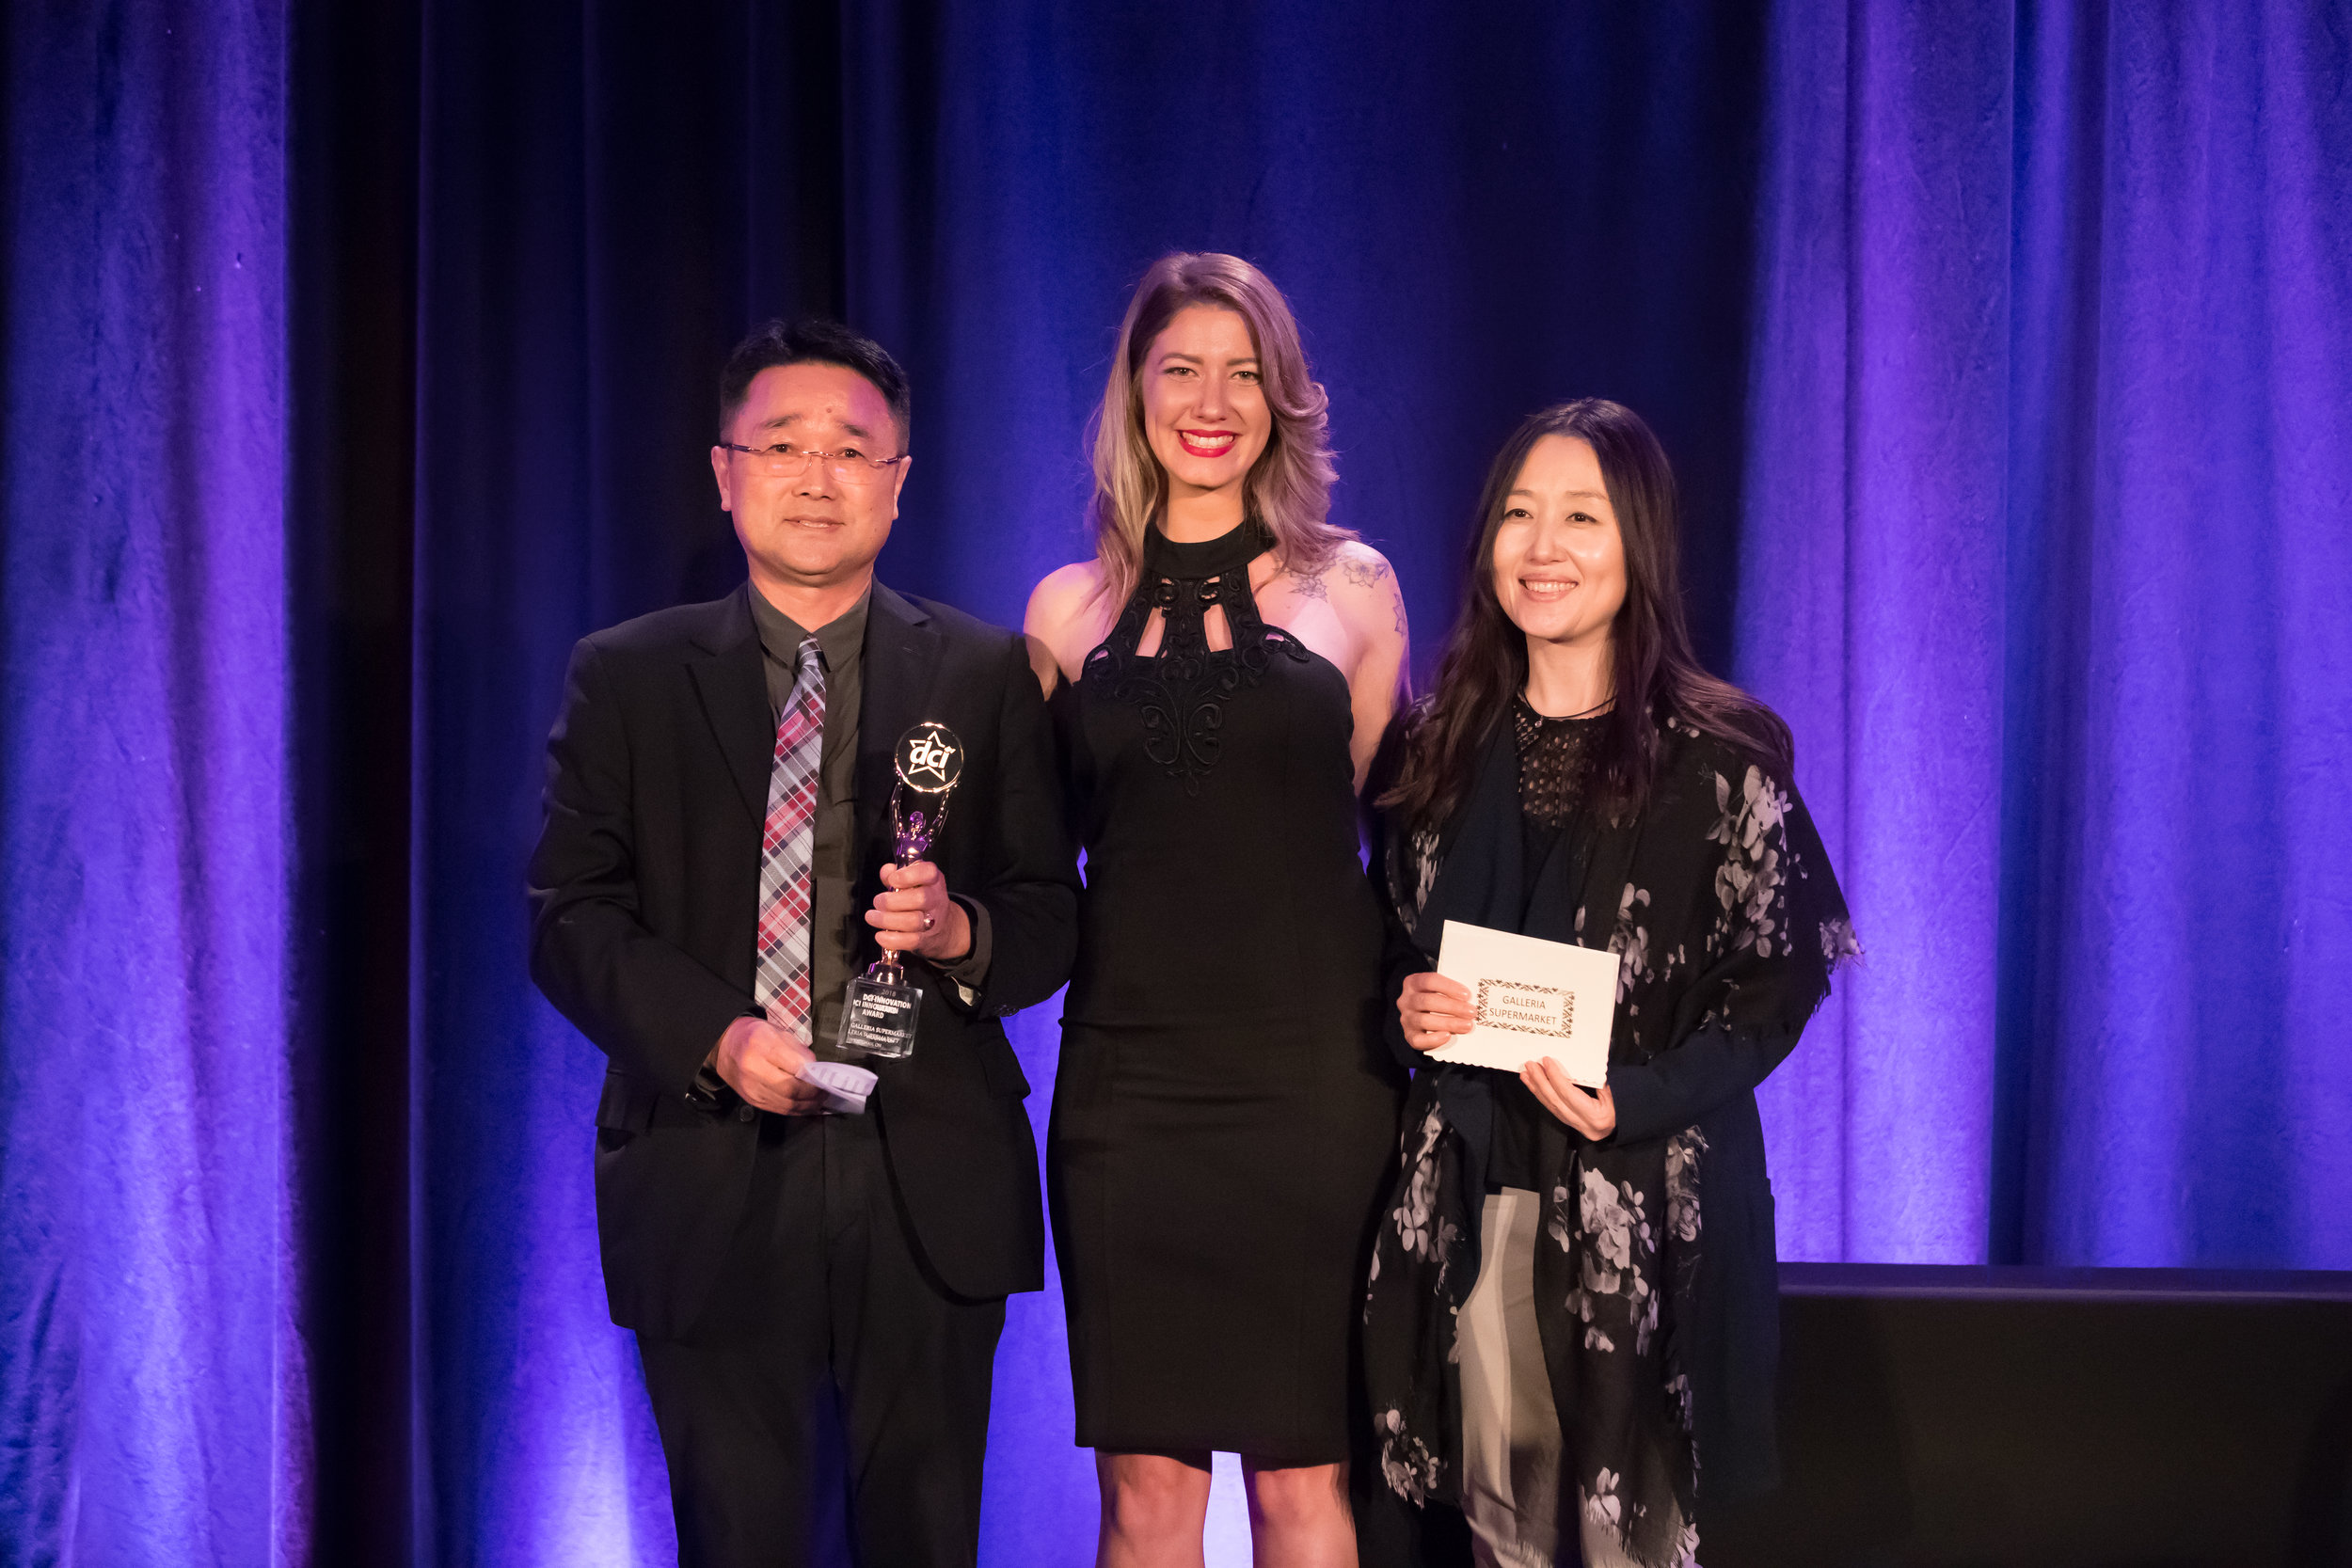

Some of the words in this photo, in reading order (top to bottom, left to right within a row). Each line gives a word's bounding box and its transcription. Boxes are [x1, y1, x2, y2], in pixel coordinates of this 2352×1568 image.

[910, 740, 951, 768] dci
[874, 995, 912, 1009] INNOVATION
[1502, 995, 1546, 1009] GALLERIA
[862, 1009, 884, 1019] AWARD
[1489, 1008, 1557, 1025] SUPERMARKET
[850, 1022, 875, 1032] GALLERIA
